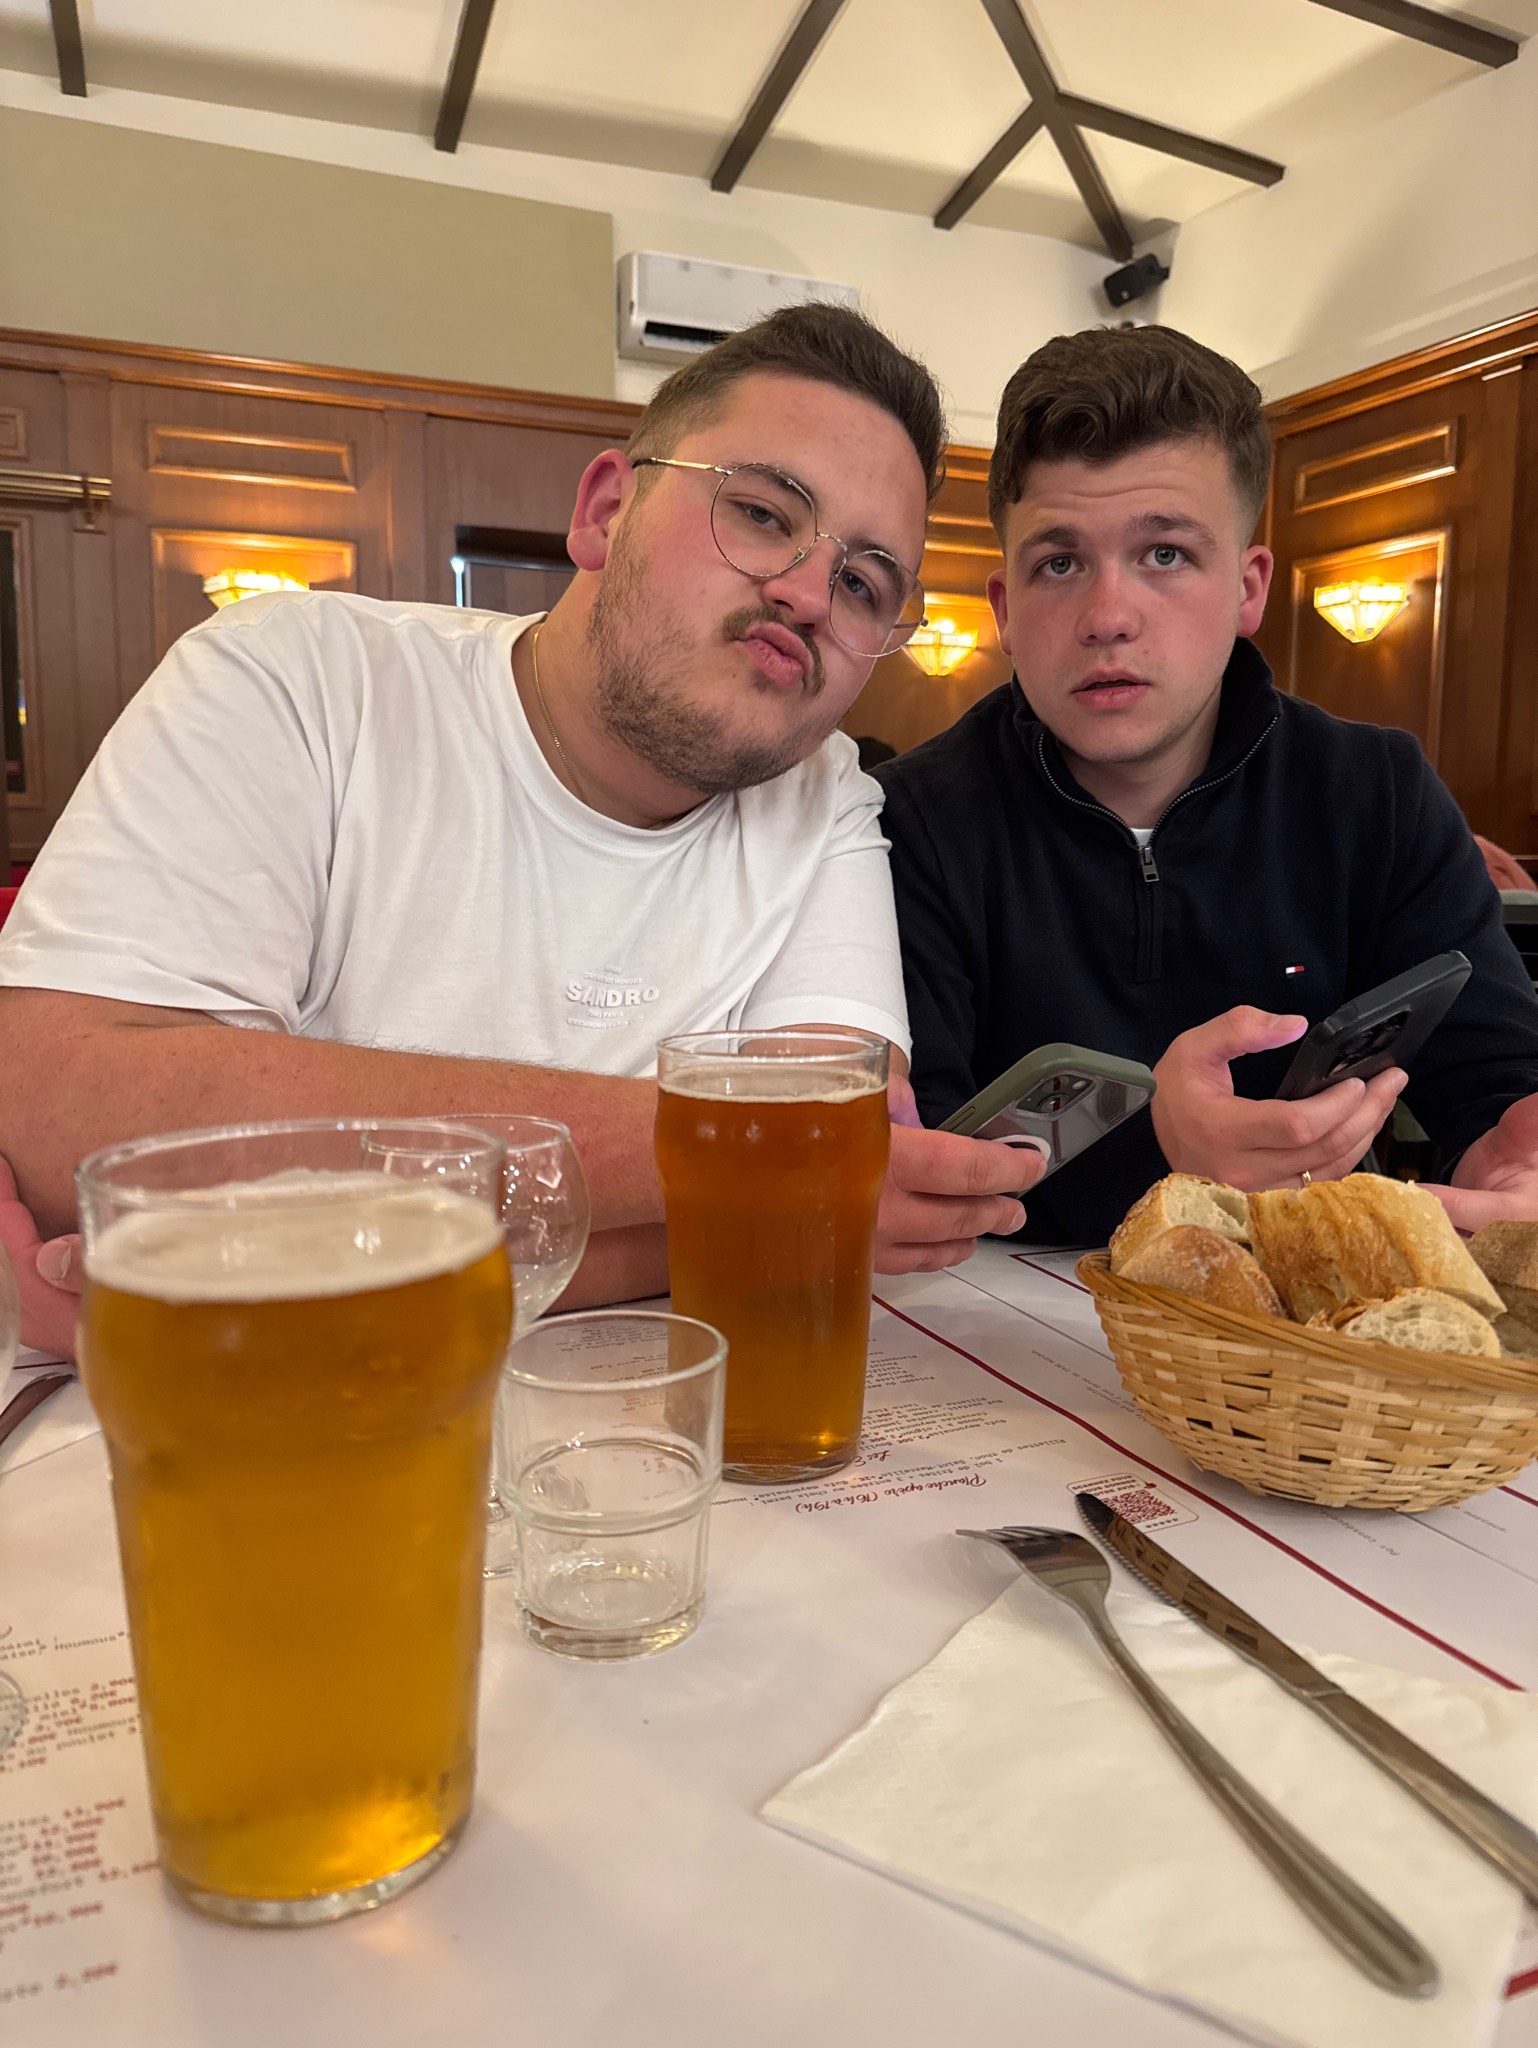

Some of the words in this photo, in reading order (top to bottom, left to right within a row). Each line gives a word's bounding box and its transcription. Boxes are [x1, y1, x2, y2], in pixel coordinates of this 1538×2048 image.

[566, 982, 660, 1008] SANDRO
[1016, 1439, 1067, 1450] Rillettes
[974, 1460, 993, 1468] bol
[919, 1468, 954, 1478] frites
[924, 1473, 987, 1491] Planche
[798, 1490, 828, 1499] choix
